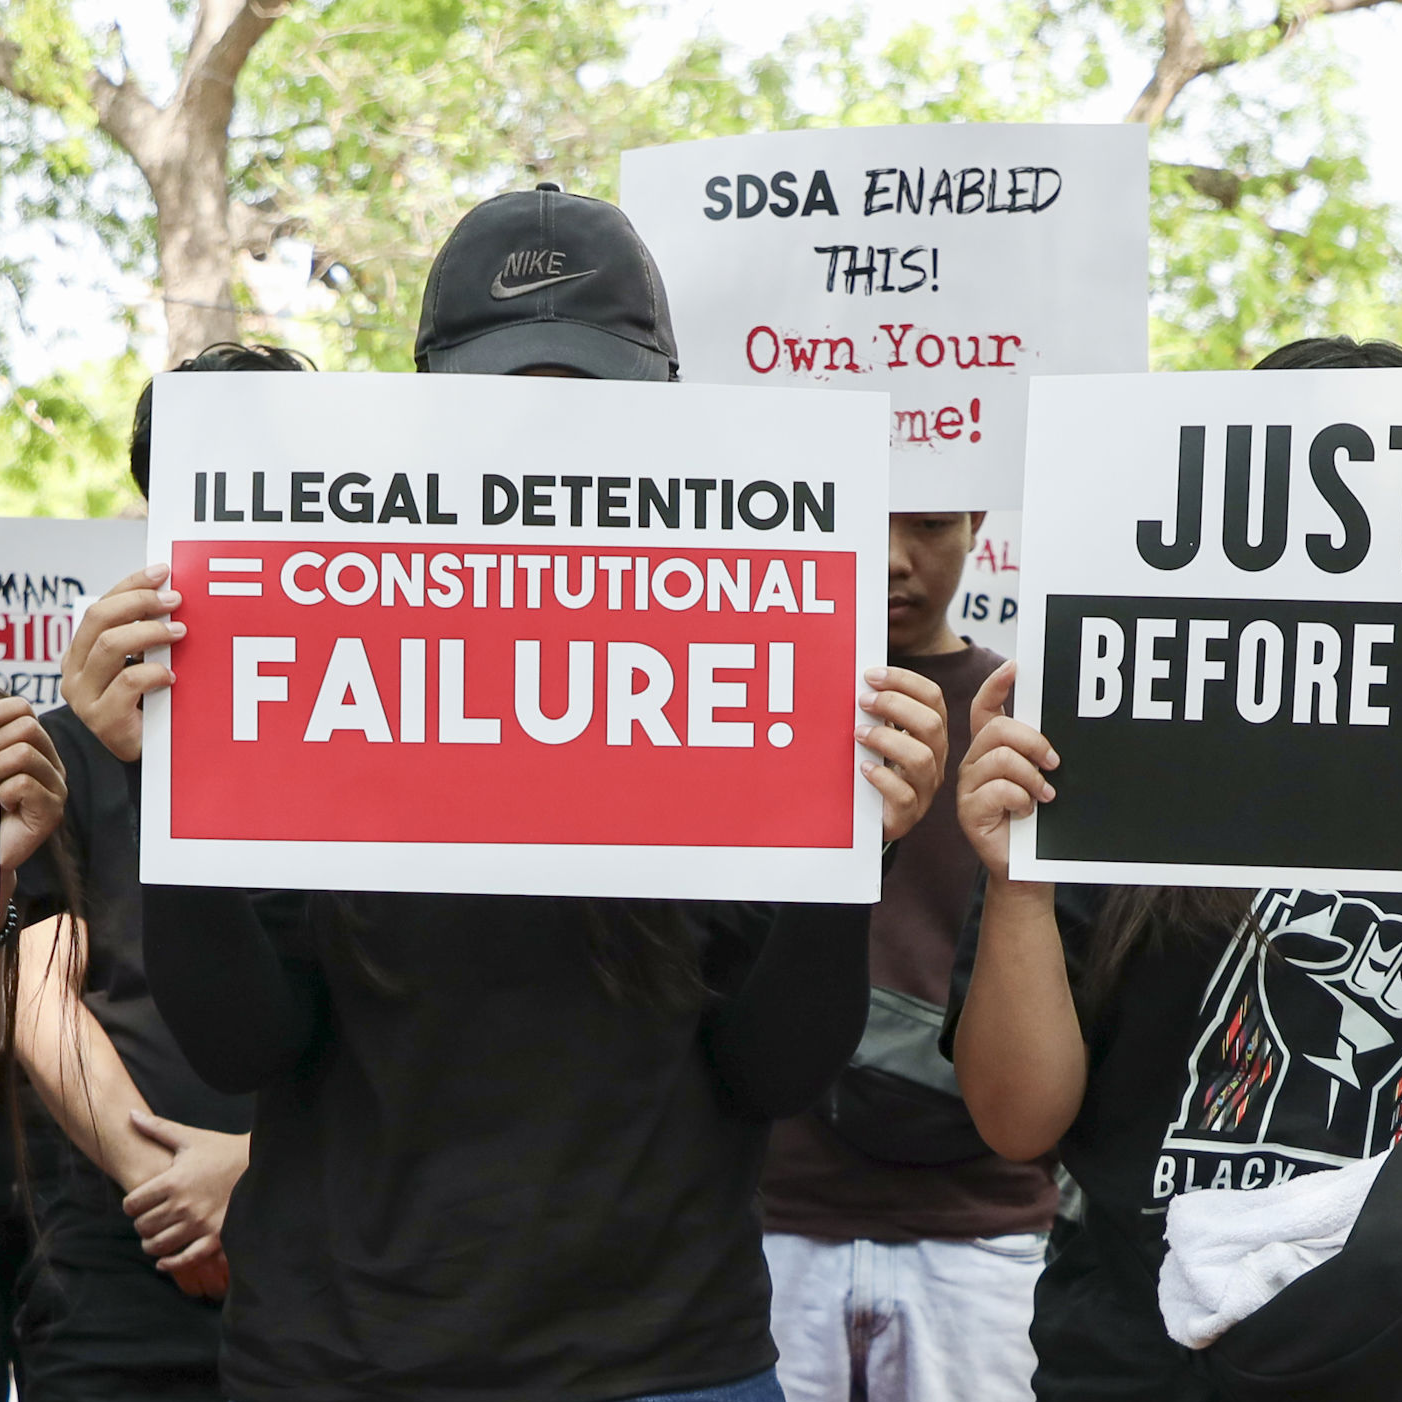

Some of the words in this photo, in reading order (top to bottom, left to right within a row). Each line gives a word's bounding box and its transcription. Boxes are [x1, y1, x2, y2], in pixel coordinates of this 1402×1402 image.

[704, 169, 839, 221] SDSA
[863, 166, 1062, 216] ENABLED
[503, 249, 567, 278] NIKE
[814, 245, 939, 296] THIS!
[746, 325, 857, 375] Own
[875, 323, 1022, 374] Your
[193, 471, 459, 525] ILLEGAL
[482, 474, 836, 533] DETENTION
[279, 551, 835, 615] CONSTITUTIONAL
[962, 591, 990, 621] IS
[232, 636, 795, 749] FAILURE!
[1077, 616, 1396, 728] BEFORE
